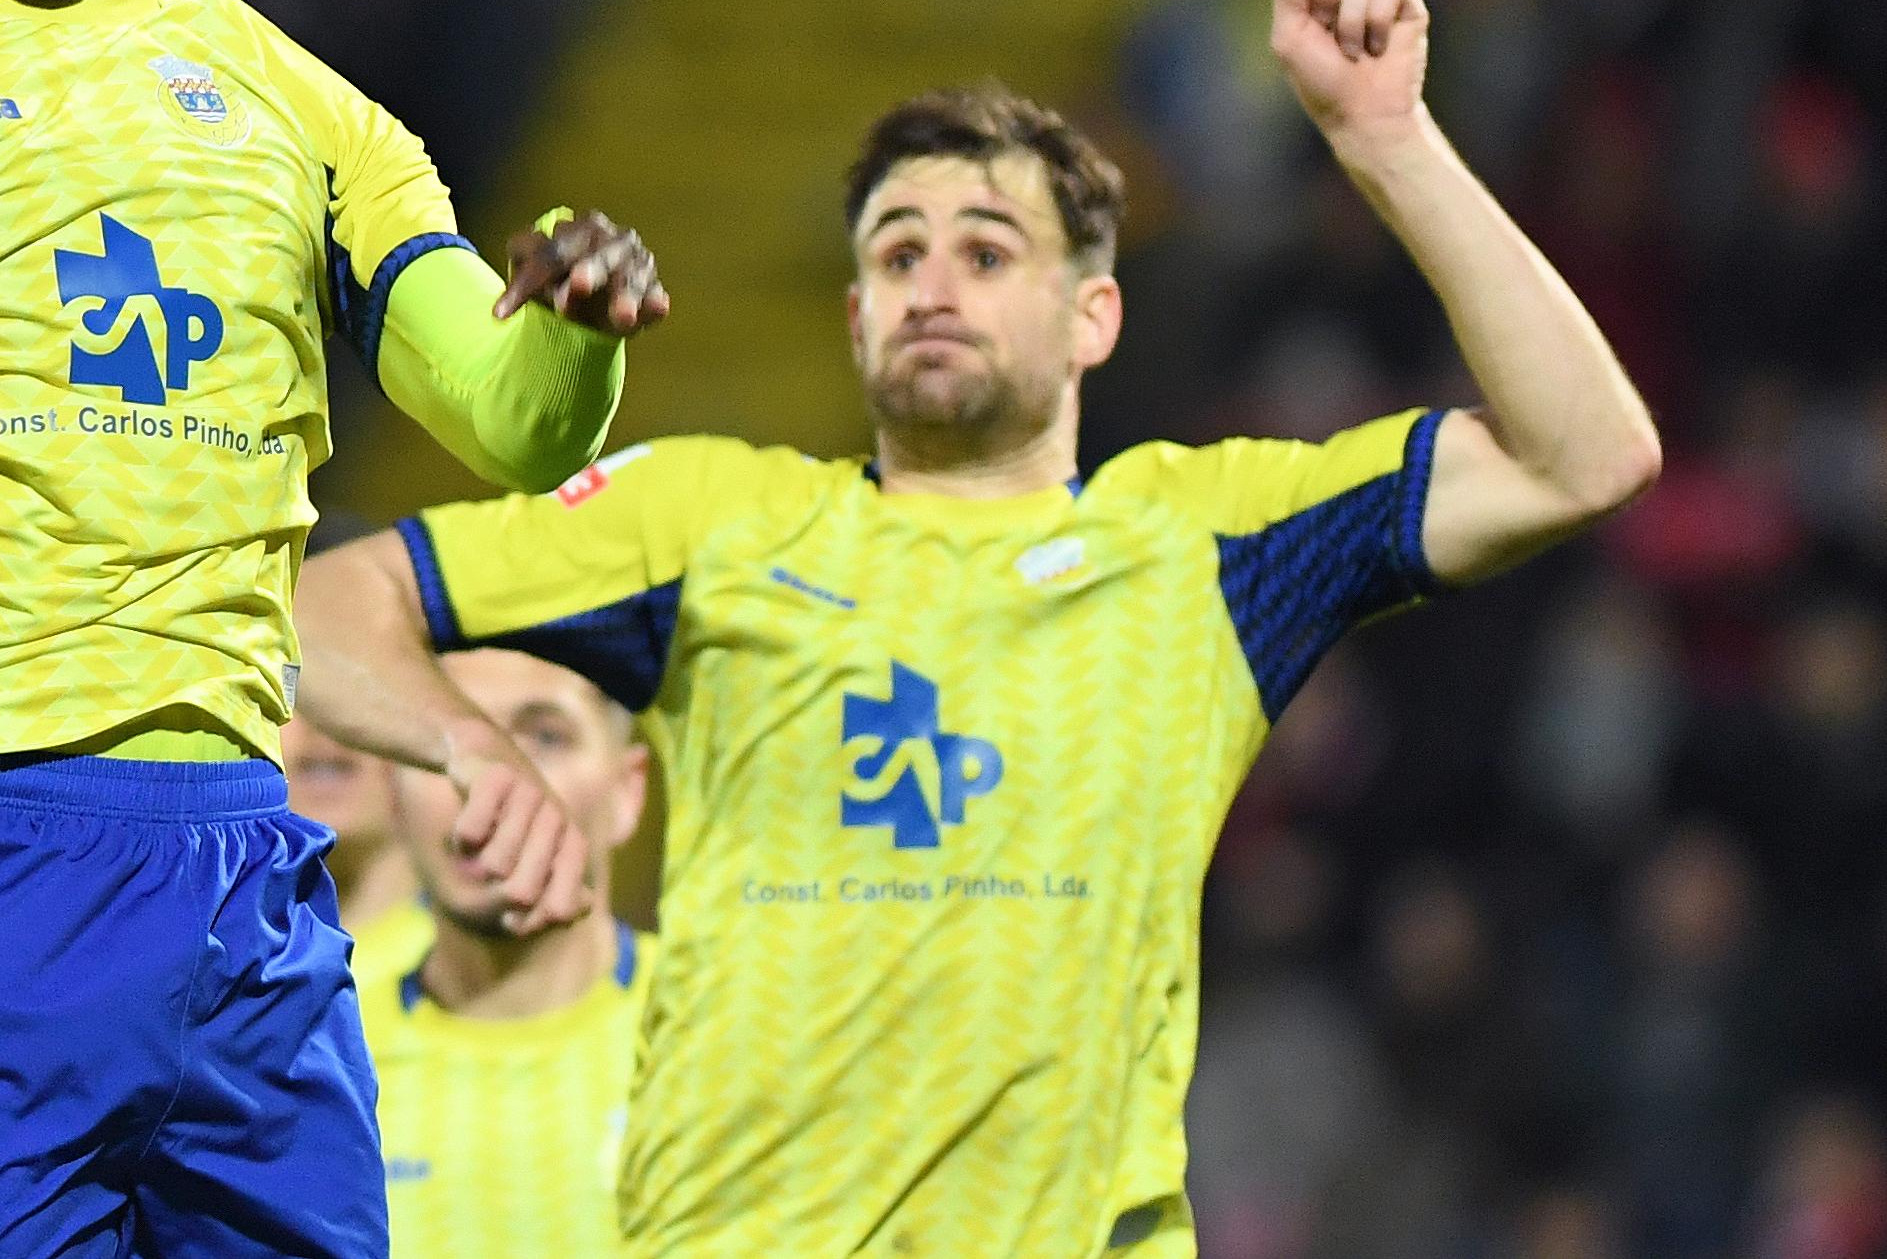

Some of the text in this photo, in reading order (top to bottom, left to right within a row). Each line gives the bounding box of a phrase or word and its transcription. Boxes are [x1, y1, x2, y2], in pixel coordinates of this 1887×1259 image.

[78, 406, 174, 439] Carlos
[183, 415, 254, 458] Pinho,
[256, 428, 289, 456] da.
[839, 876, 935, 903] Carlos
